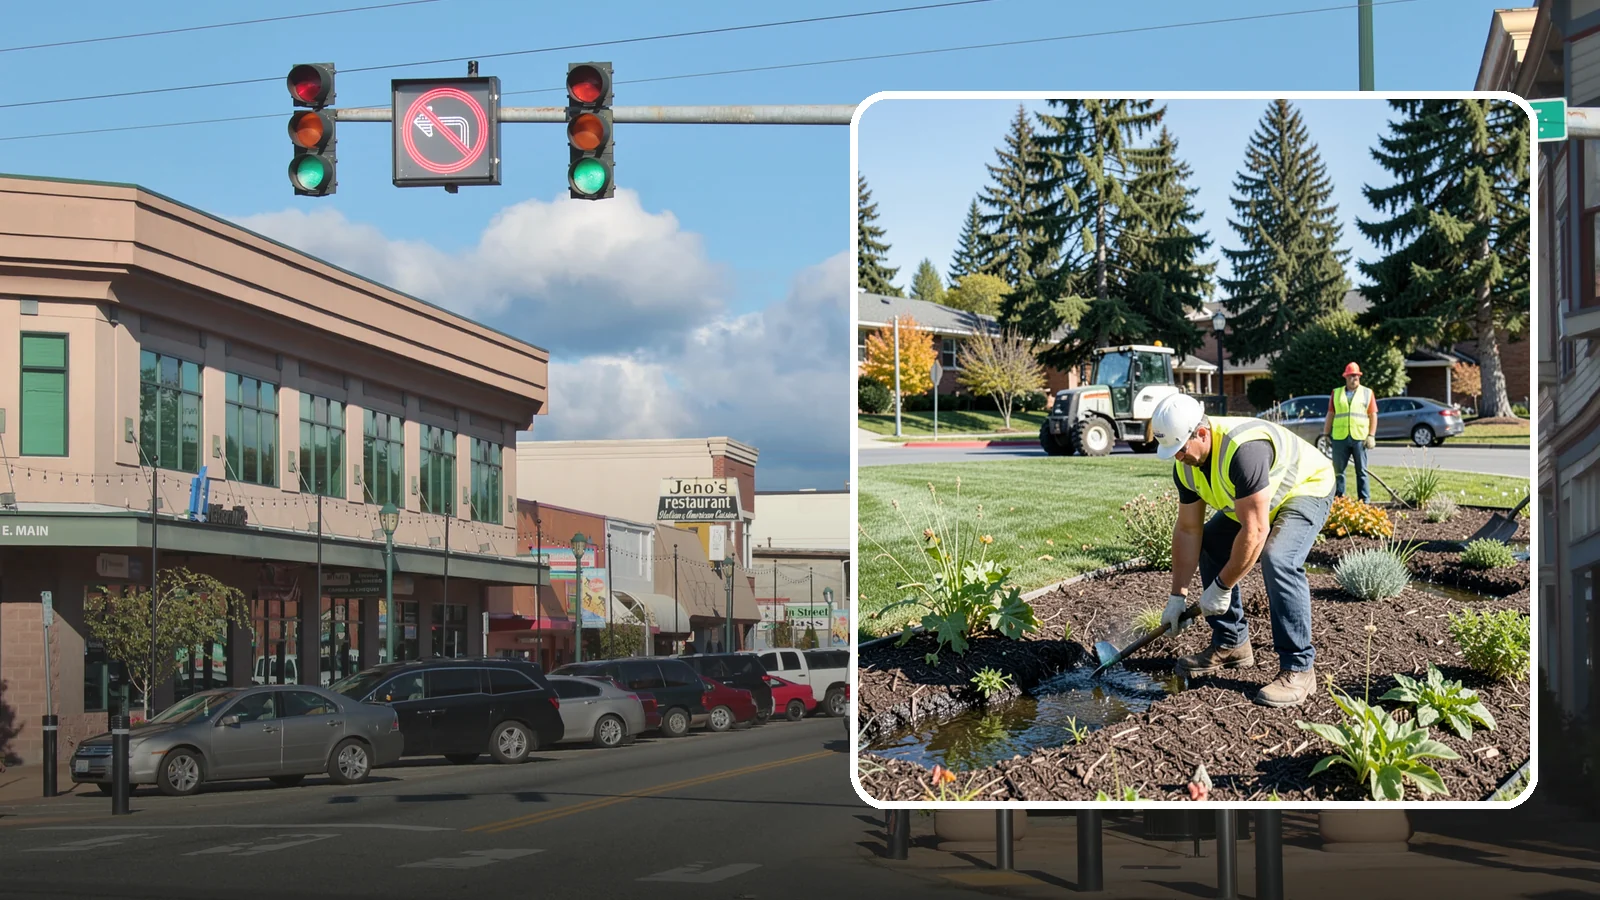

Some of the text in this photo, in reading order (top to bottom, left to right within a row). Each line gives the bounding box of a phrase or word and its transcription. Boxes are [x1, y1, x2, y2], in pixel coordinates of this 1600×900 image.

[670, 480, 727, 494] Jeno's
[665, 496, 731, 508] restaurant
[659, 510, 682, 520] Italian
[686, 510, 714, 520] American
[715, 510, 738, 520] Cuisine
[2, 525, 48, 536] E. MAIN
[798, 608, 828, 617] Street
